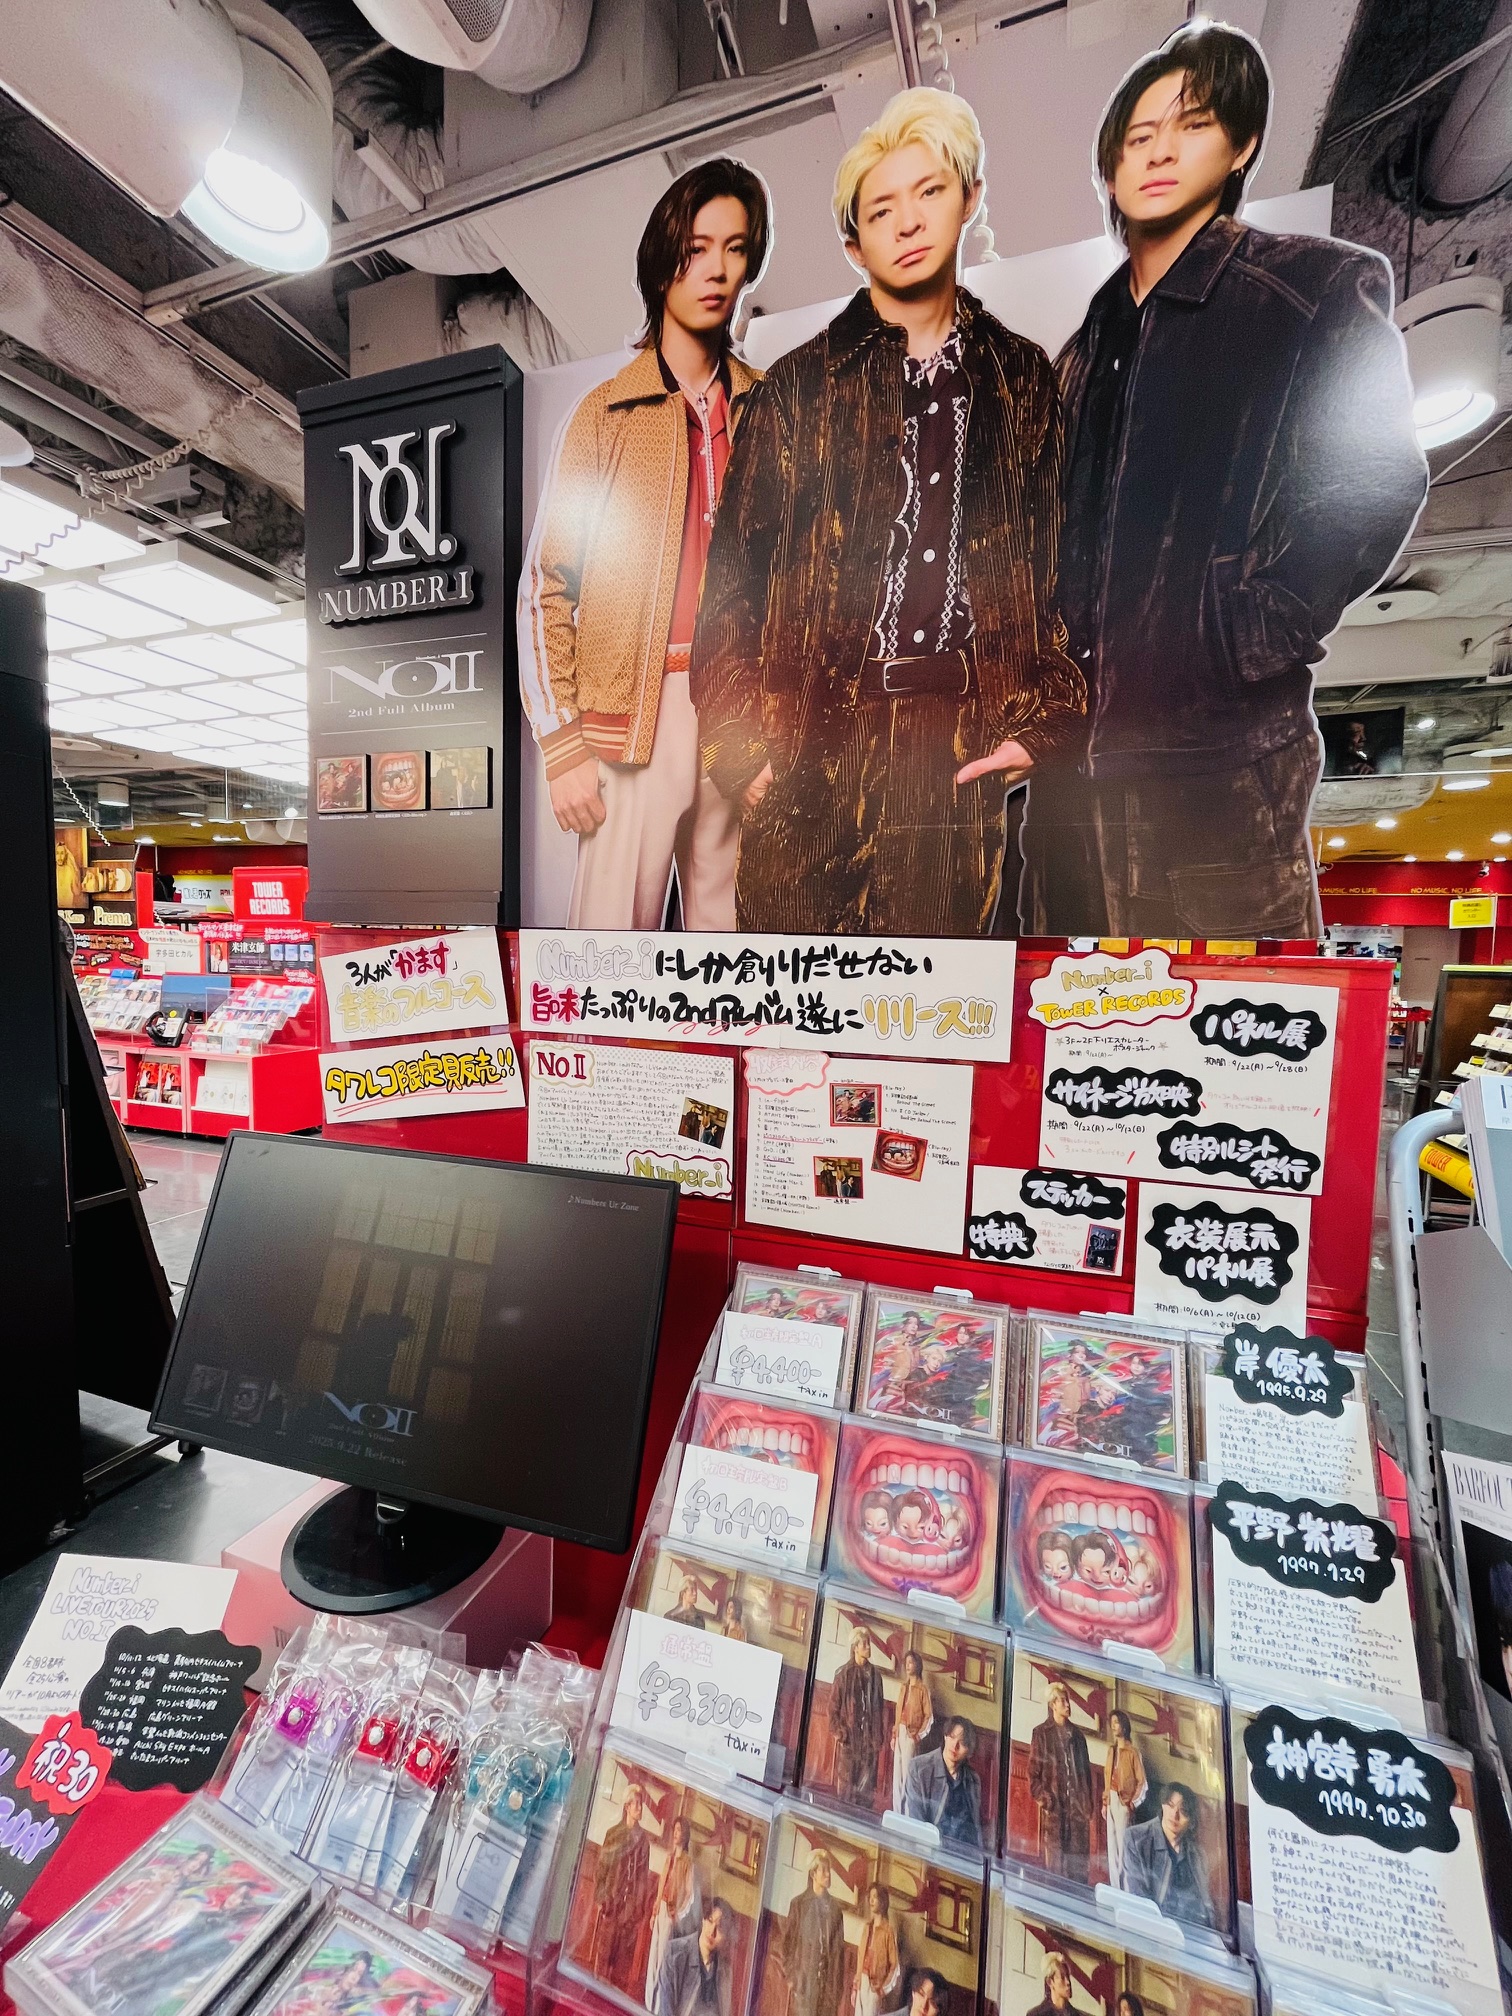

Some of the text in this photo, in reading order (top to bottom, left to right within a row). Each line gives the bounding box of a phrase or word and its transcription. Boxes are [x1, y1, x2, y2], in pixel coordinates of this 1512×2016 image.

[349, 702, 455, 717] 2nd Full Album
[252, 882, 283, 898] TOWER
[94, 907, 132, 926] Prema
[249, 899, 291, 915] RECORDS
[156, 949, 193, 958] 宇多田ヒカル
[232, 942, 265, 953] 米津玄師
[1037, 988, 1186, 1023] TOWER RECORDS
[1205, 1010, 1311, 1050] パネル展
[1053, 1077, 1192, 1112] サイネージ放映
[1170, 1133, 1279, 1164] 特別レシート
[1425, 1149, 1452, 1172] TOWER
[1251, 1156, 1311, 1184] 発行
[1026, 1179, 1112, 1209] ステッカー
[969, 1218, 1029, 1253] 特典
[1166, 1218, 1280, 1252] 衣装展示
[1185, 1256, 1277, 1287] パネル展
[1234, 1338, 1260, 1381] 岸
[1226, 1501, 1297, 1548] 平野
[660, 1633, 713, 1667] 通常盤
[1266, 1725, 1431, 1801] 神宮寺 勇太
